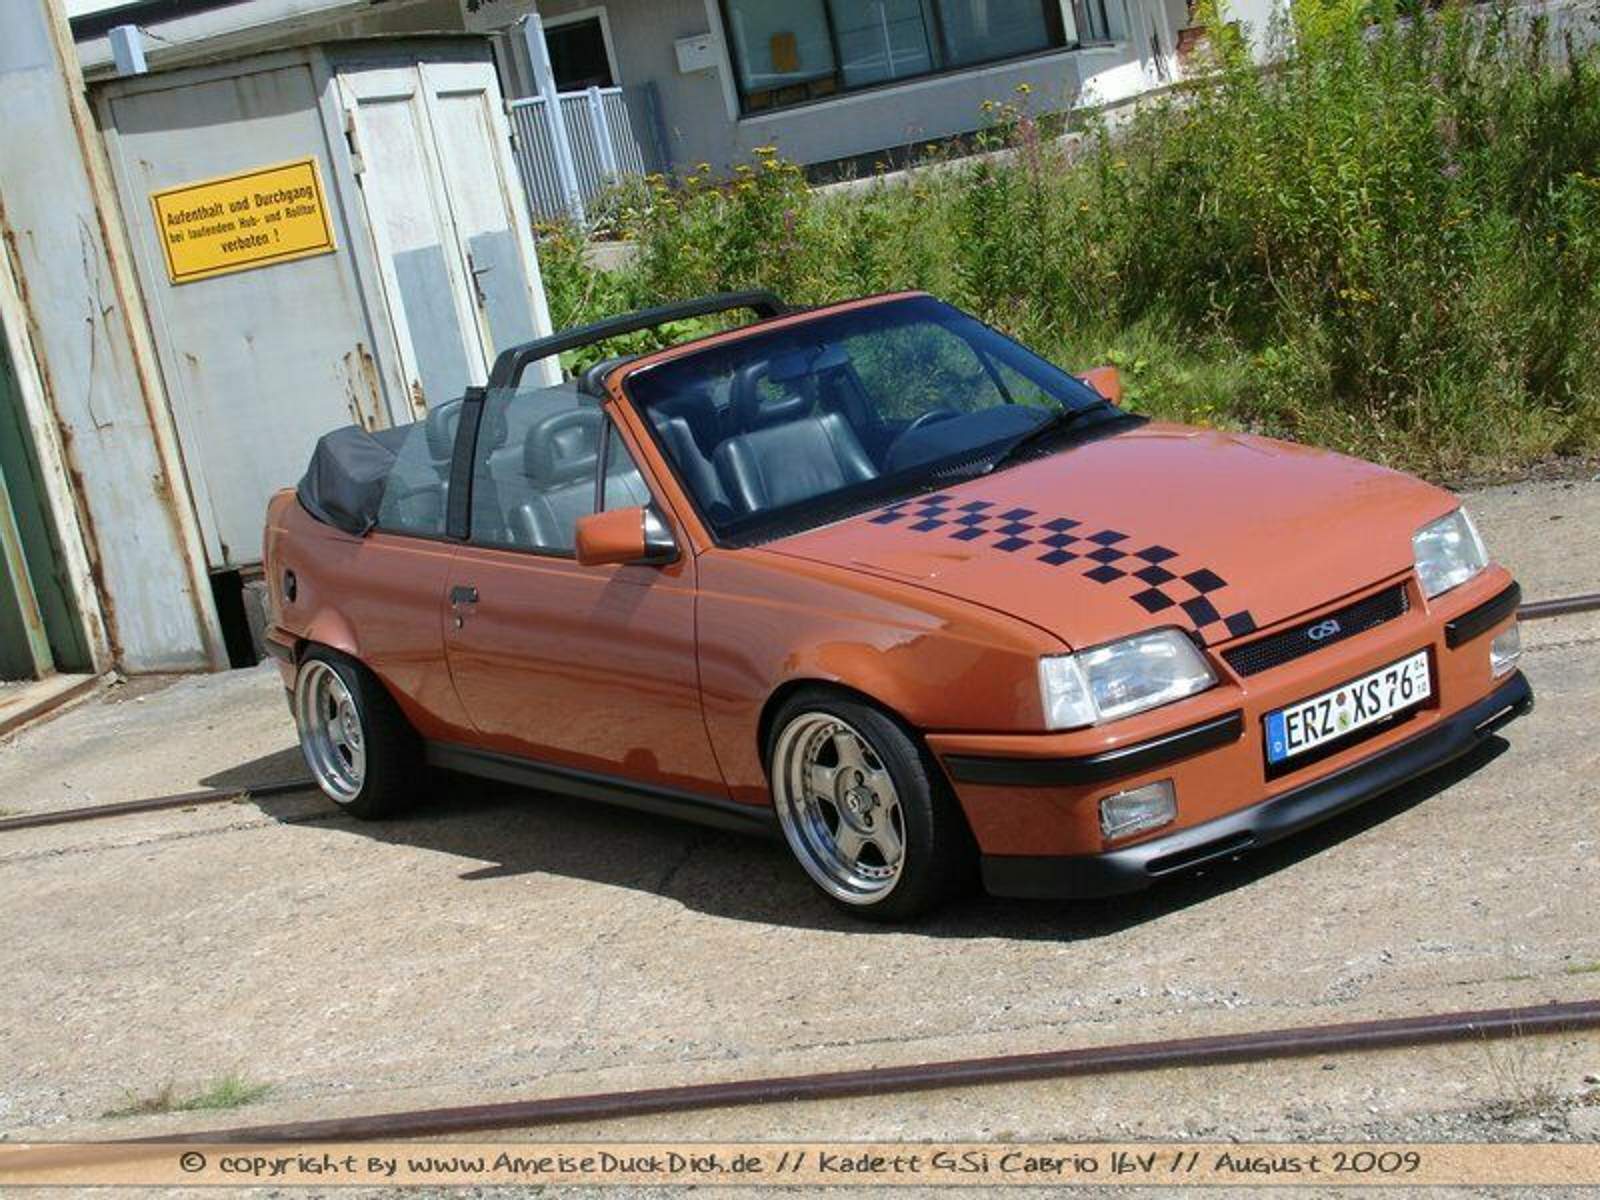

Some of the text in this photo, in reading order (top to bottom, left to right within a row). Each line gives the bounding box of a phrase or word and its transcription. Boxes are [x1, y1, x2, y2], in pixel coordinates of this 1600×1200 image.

[167, 185, 314, 226] Aufenthalt und Durchgang
[169, 231, 184, 243] bei
[187, 221, 236, 239] laufendem
[264, 211, 281, 223] und
[220, 232, 269, 253] verboten
[1286, 699, 1335, 750] ERZ
